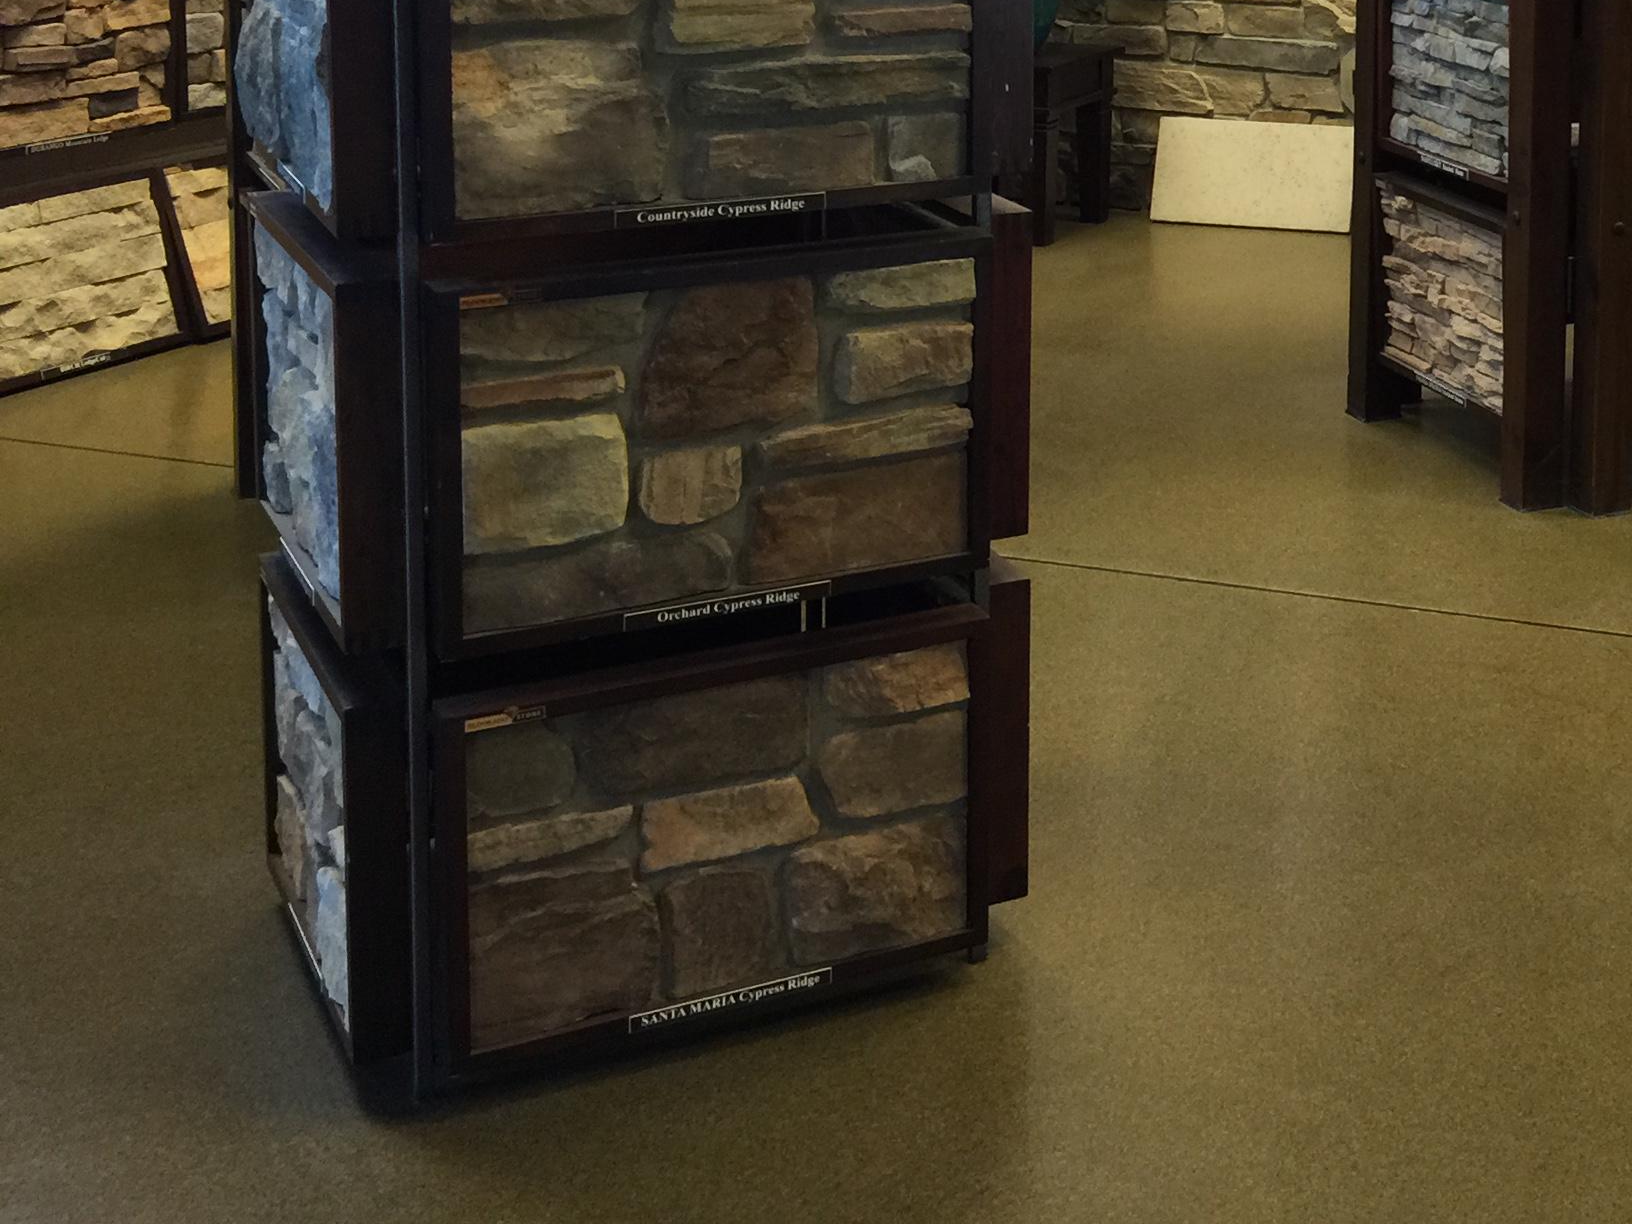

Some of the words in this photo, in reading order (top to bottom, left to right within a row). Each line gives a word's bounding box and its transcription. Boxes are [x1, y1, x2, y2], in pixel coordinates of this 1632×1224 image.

[636, 206, 715, 224] Countryside
[717, 201, 767, 218] Cypress
[769, 198, 806, 212] Ridge
[657, 603, 711, 623] Orchard
[713, 598, 763, 615] Cypress
[765, 590, 801, 605] Ridge
[640, 1007, 687, 1027] SANTA
[689, 995, 736, 1016] MARIA
[738, 983, 785, 1003] Cypress
[787, 973, 821, 991] Ridge
